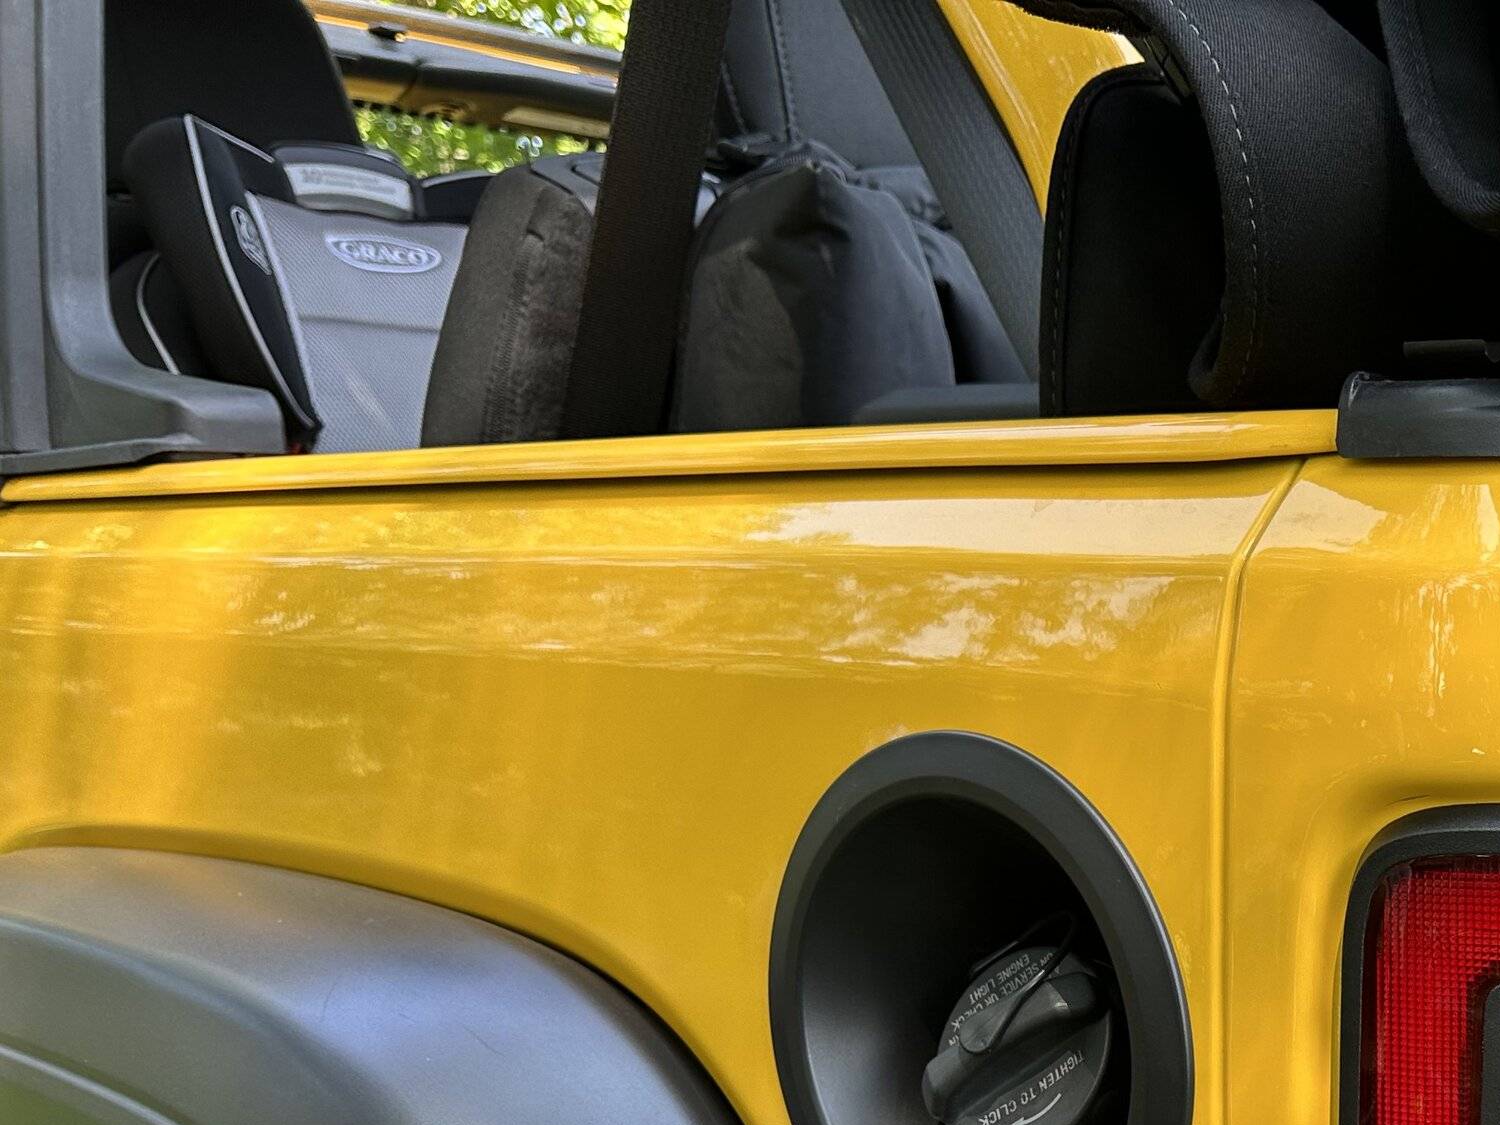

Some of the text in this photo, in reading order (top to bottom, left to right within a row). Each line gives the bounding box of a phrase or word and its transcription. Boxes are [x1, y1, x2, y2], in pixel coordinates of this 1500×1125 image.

[339, 241, 431, 267] GRACO
[996, 954, 1031, 981] ENGINE
[1000, 963, 1040, 996] SERVICE
[968, 978, 996, 1005] LIGHT
[1038, 1050, 1085, 1092] TIGHTEN
[1020, 1088, 1037, 1105] TO
